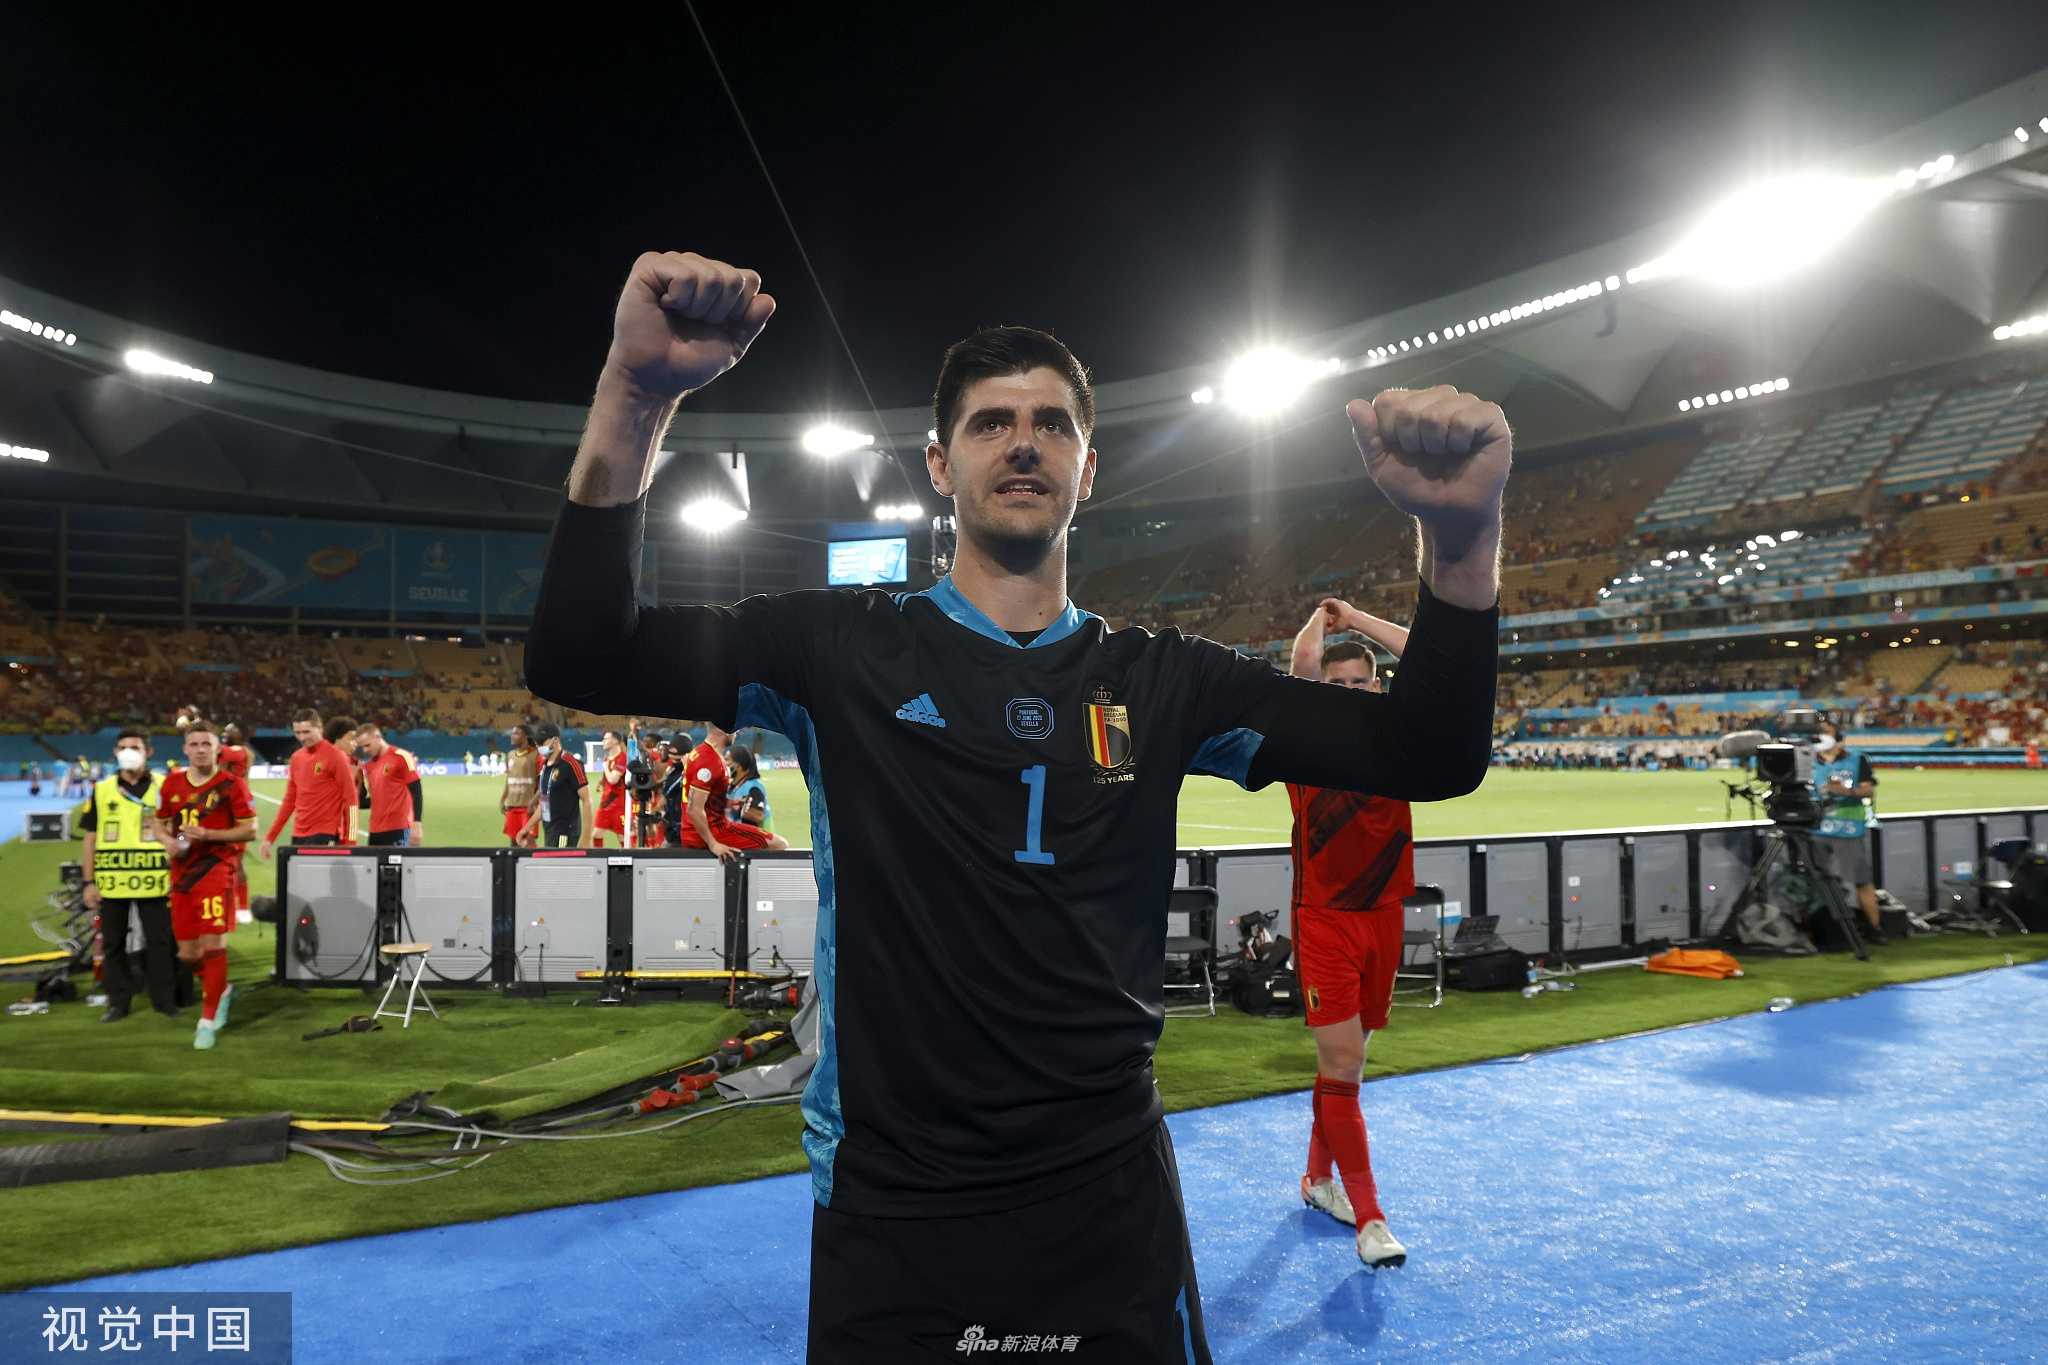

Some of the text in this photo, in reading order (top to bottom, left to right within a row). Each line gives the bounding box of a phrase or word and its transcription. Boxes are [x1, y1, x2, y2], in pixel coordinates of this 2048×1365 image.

[408, 585, 468, 602] SEVILLE
[896, 708, 945, 728] adidas
[1107, 773, 1135, 784] YEARS
[180, 808, 200, 827] 16
[1014, 765, 1055, 865] 1
[201, 895, 224, 919] 16
